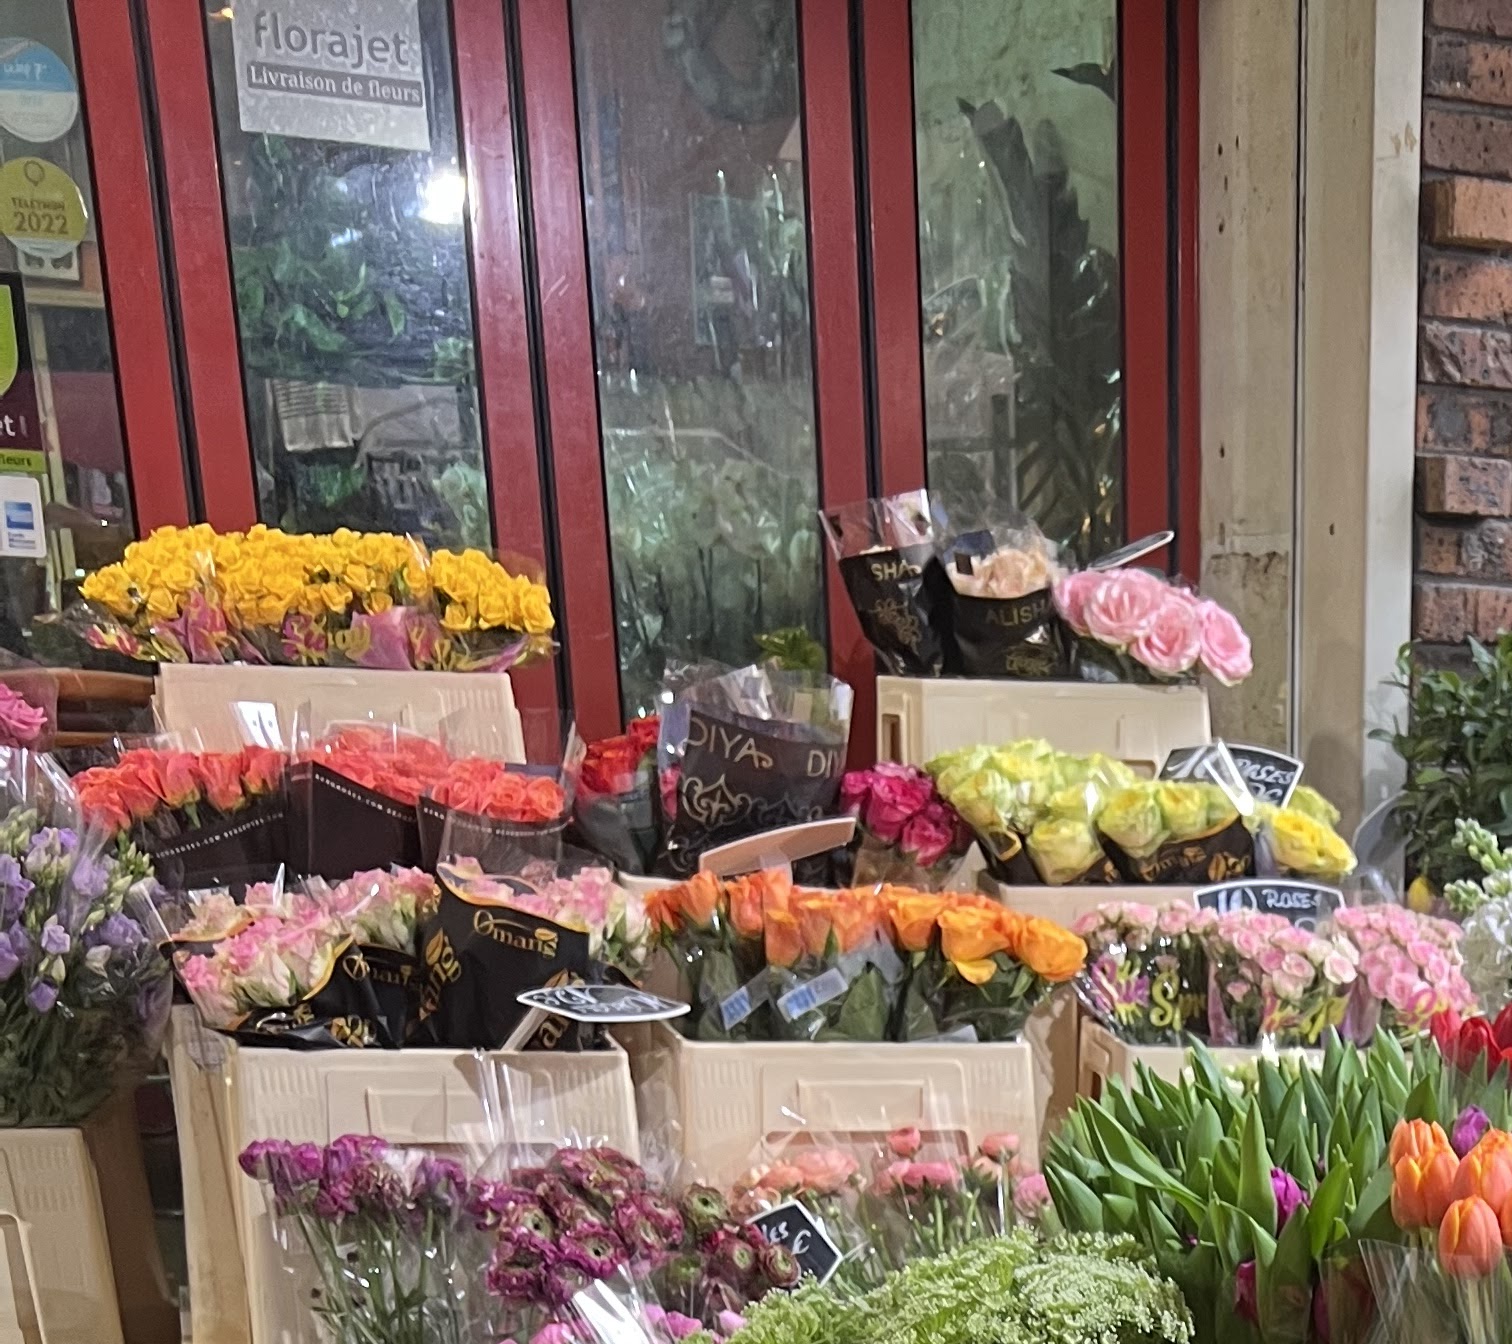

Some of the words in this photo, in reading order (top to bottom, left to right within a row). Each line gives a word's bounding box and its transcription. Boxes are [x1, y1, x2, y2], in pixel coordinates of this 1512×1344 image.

[254, 10, 409, 69] florajet
[250, 65, 337, 93] Livraison
[341, 76, 364, 96] de
[368, 80, 421, 102] fleurs
[13, 211, 69, 235] 2022
